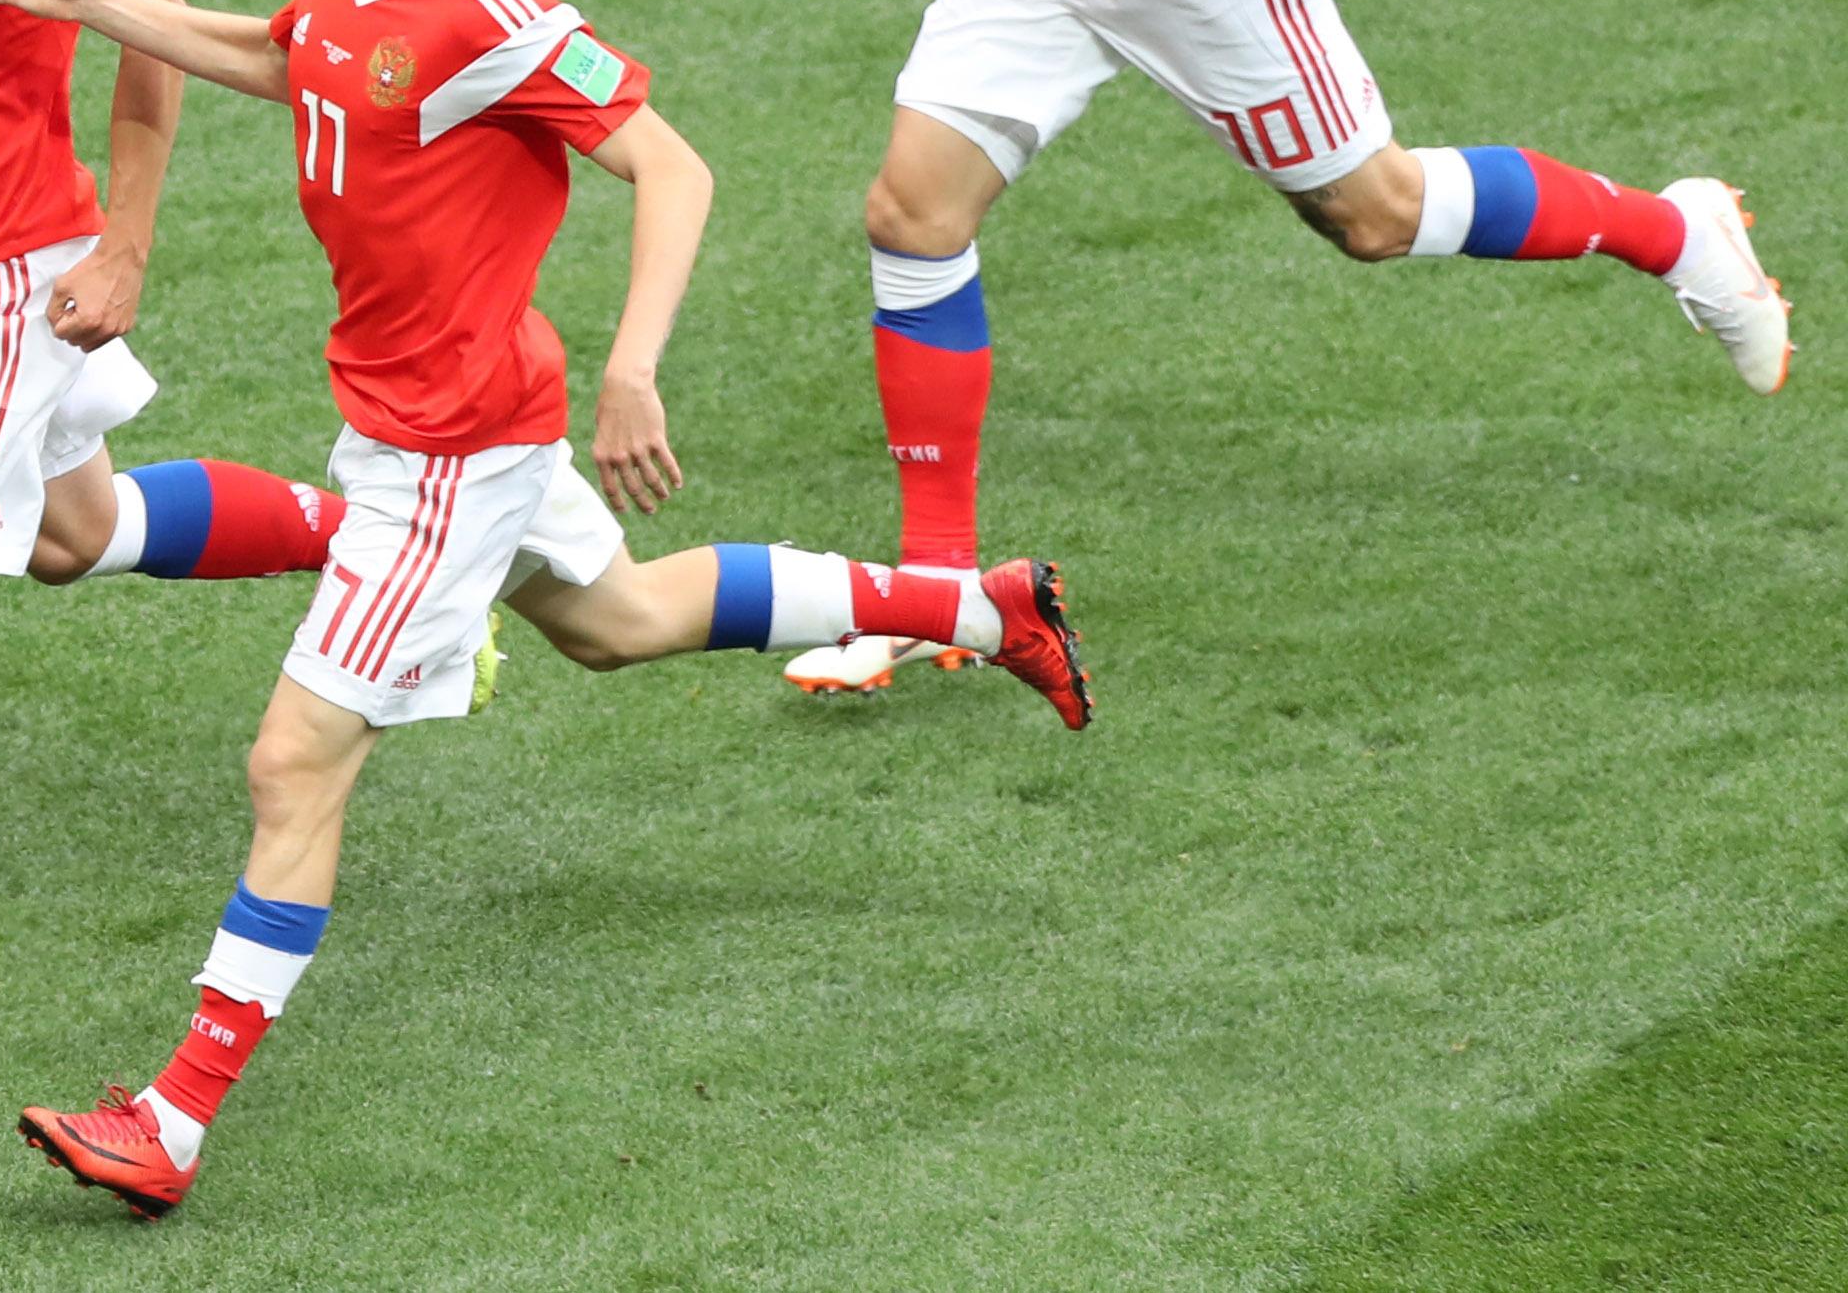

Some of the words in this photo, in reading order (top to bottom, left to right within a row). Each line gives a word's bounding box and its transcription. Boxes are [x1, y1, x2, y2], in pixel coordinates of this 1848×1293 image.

[301, 88, 346, 197] 17
[1210, 96, 1314, 169] 10
[888, 445, 940, 462] СИЯ
[310, 557, 364, 656] 7
